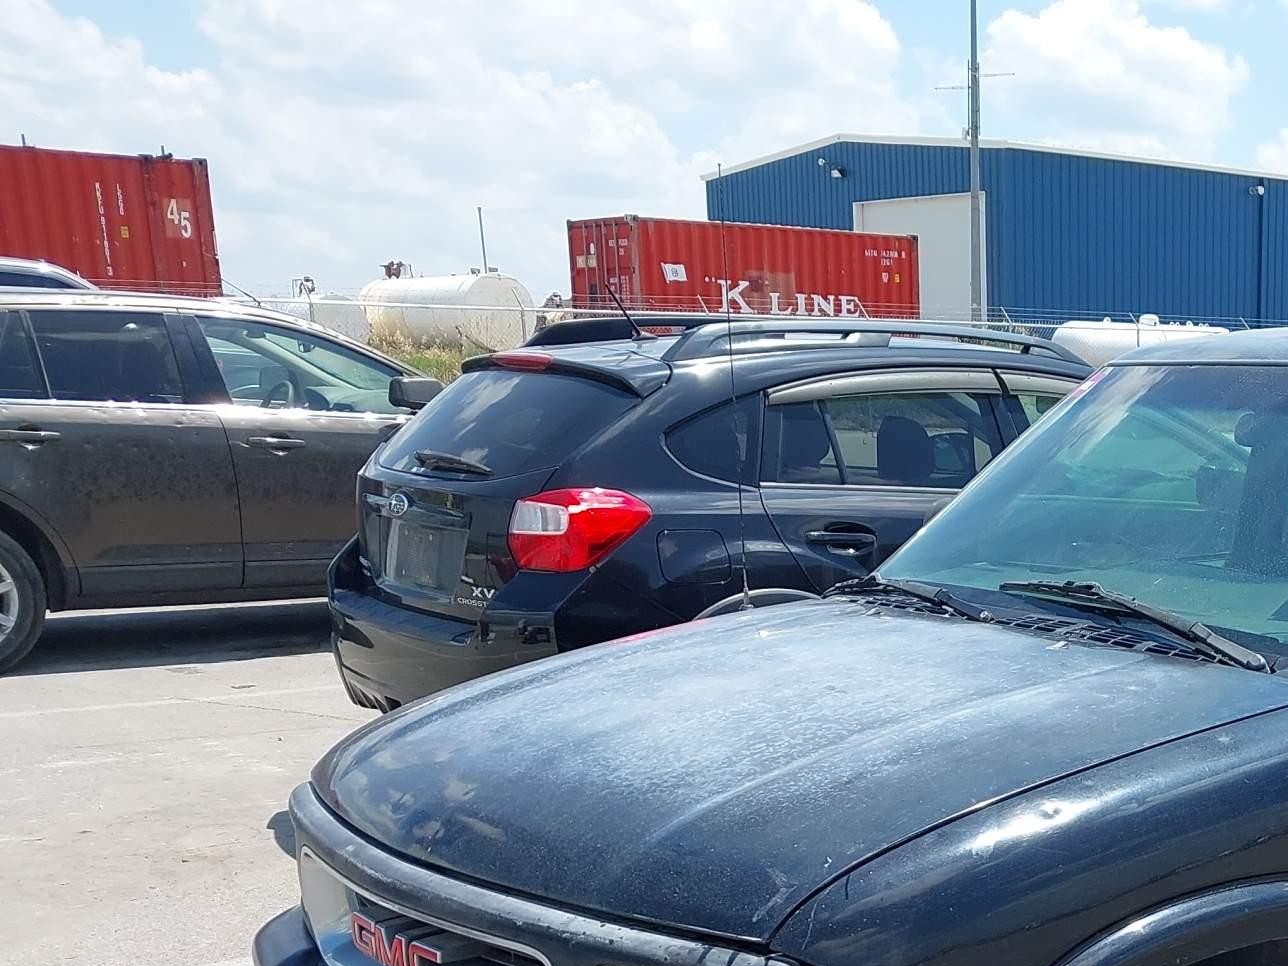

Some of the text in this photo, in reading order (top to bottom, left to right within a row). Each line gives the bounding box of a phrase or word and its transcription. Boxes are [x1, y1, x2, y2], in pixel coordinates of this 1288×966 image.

[167, 198, 192, 239] 45
[769, 292, 861, 318] LINE
[471, 586, 496, 599] XV
